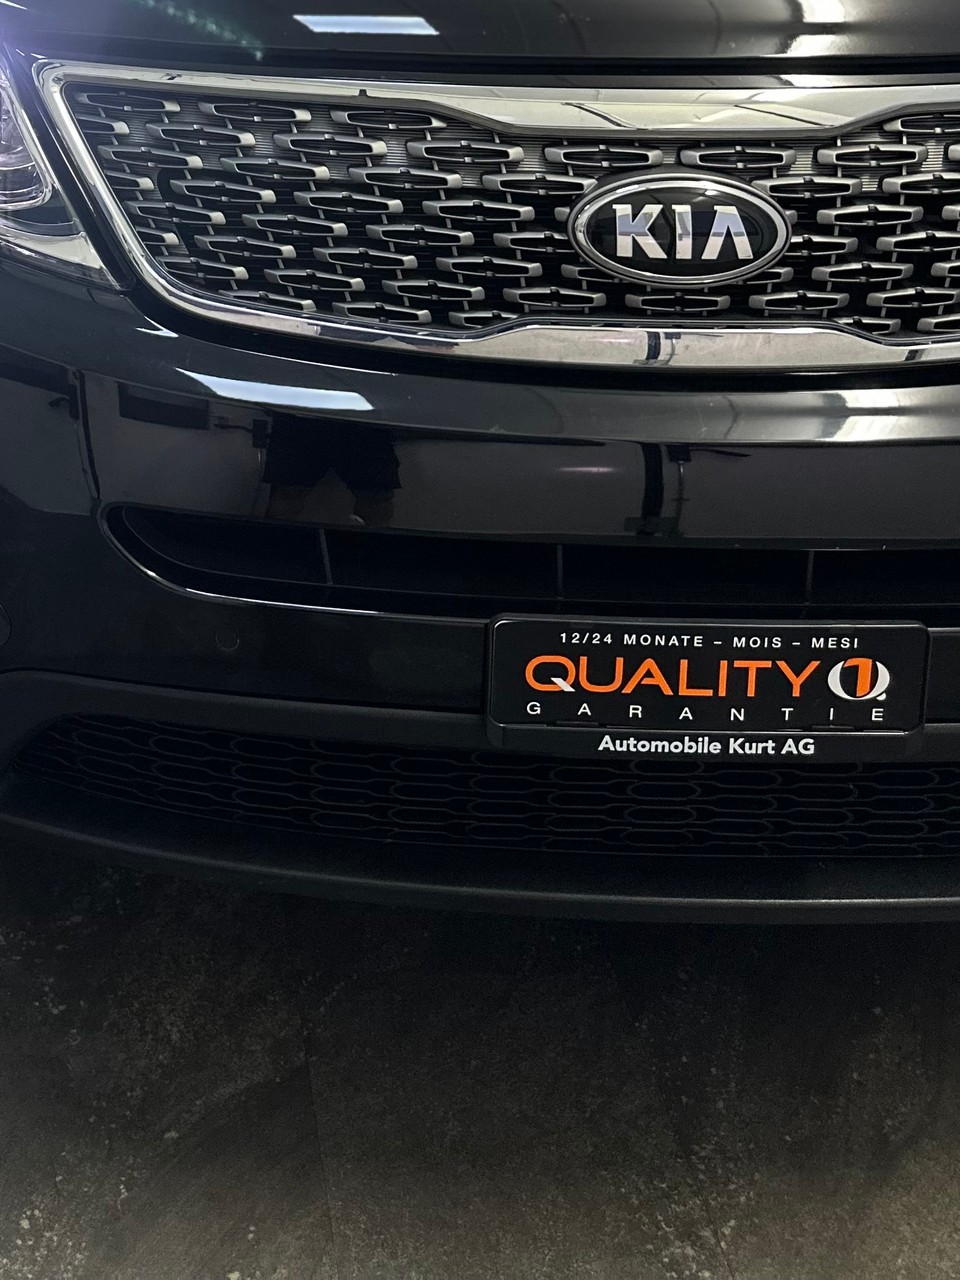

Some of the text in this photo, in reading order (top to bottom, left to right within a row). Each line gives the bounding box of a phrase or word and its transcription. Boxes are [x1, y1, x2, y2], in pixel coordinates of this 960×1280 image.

[612, 204, 754, 260] KIA
[559, 632, 613, 645] 12/24
[623, 634, 704, 647] MONATE
[732, 636, 782, 649] MOIS
[811, 637, 858, 649] MESI
[525, 655, 821, 697] QUALITY
[598, 735, 815, 755] Automobile Kurt AG
